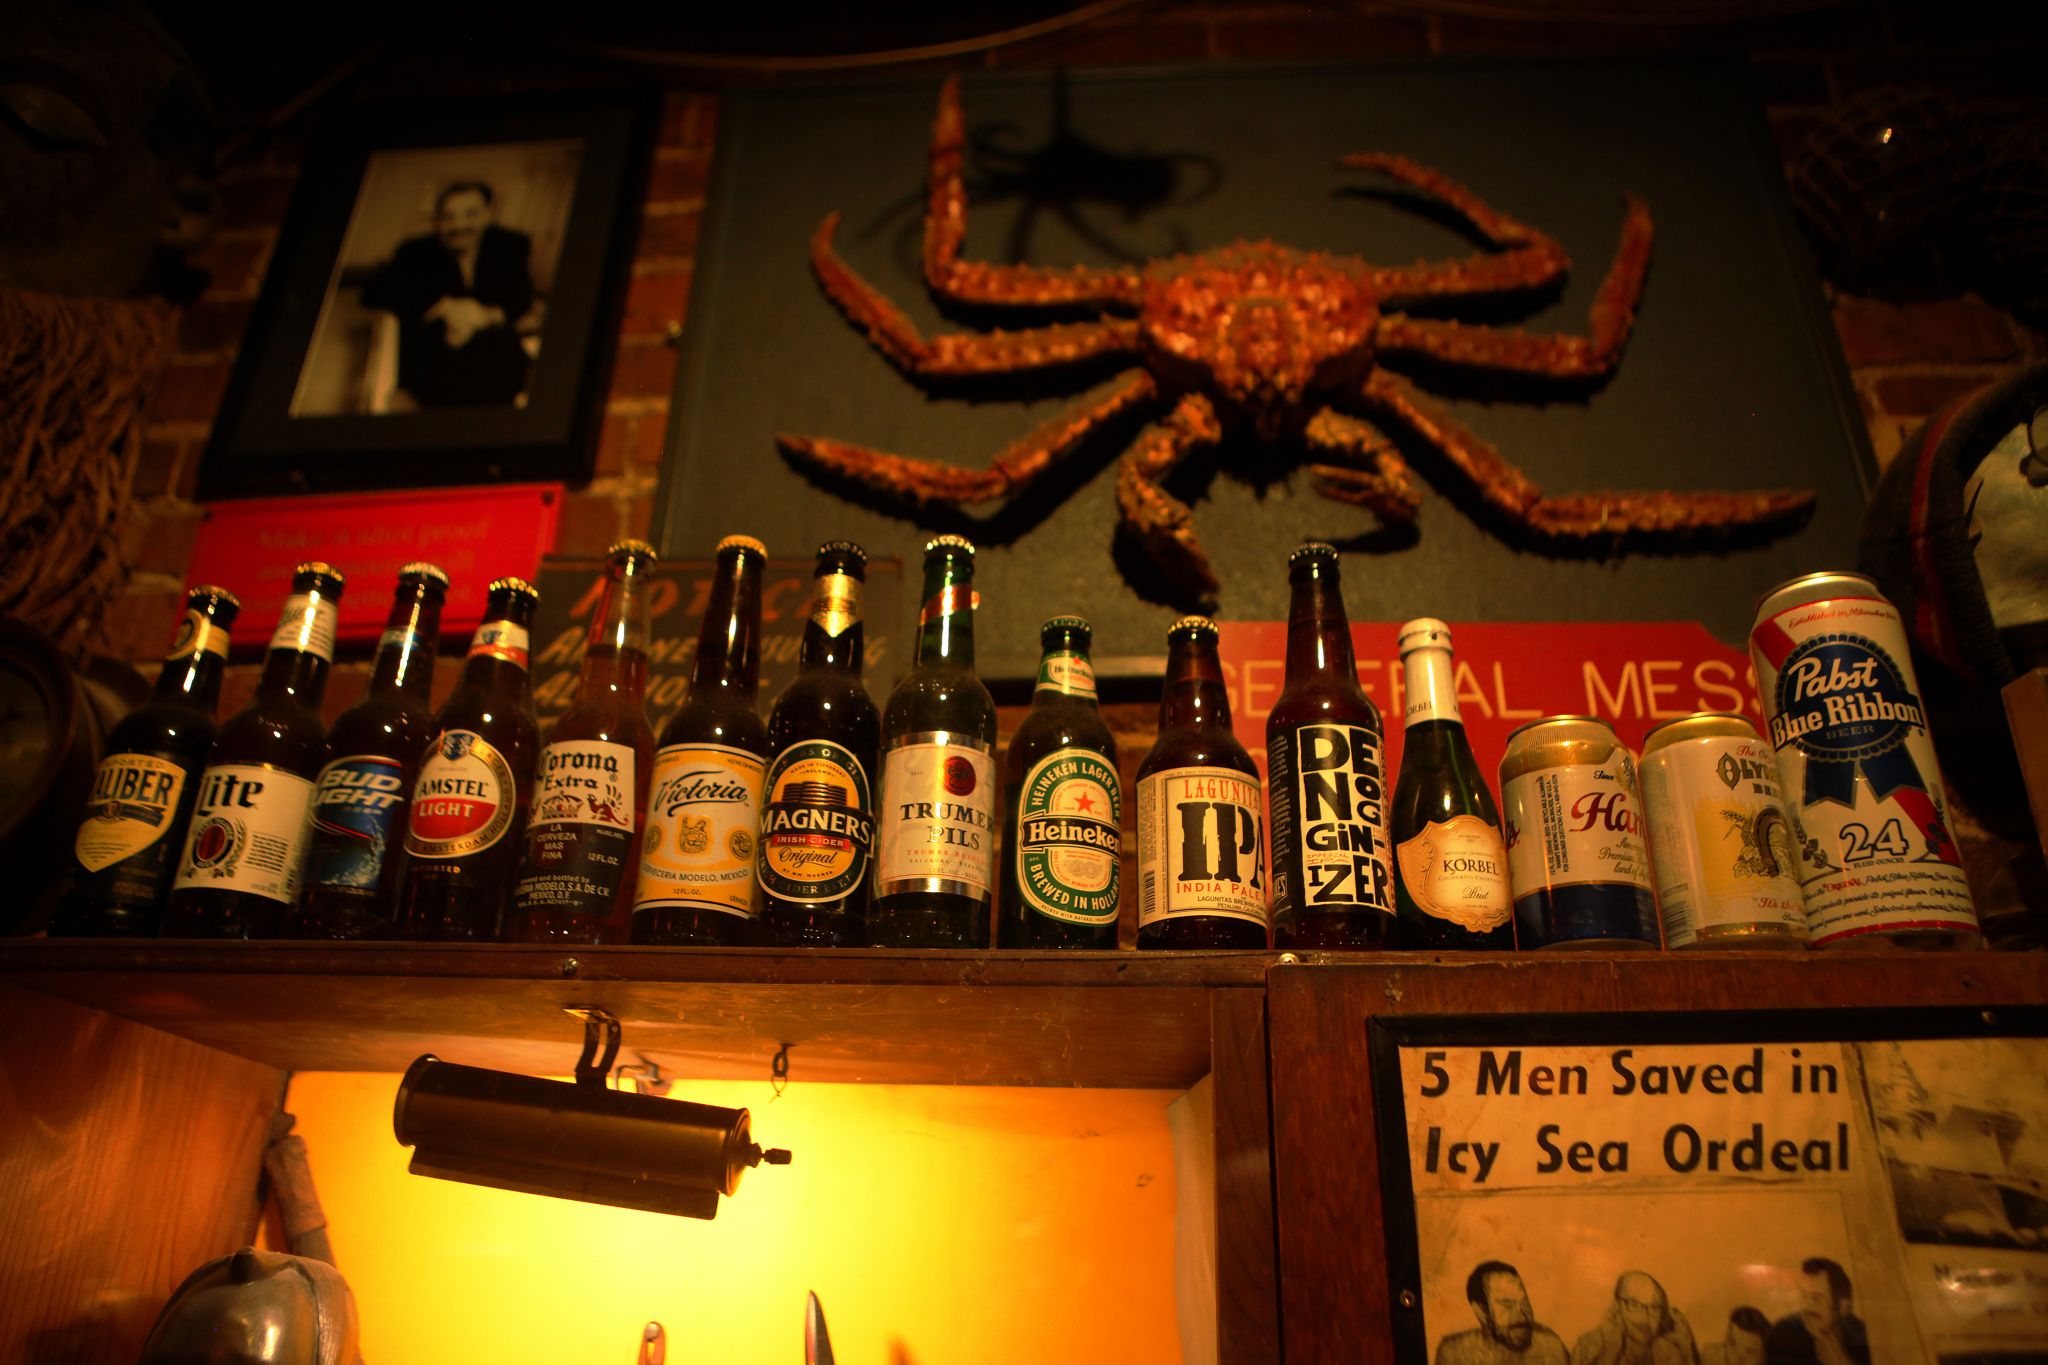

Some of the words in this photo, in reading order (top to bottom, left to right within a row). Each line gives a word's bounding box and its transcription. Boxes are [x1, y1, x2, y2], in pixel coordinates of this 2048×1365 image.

[1787, 656, 1879, 702] Pabst
[1771, 711, 1824, 749] Blue
[1823, 691, 1923, 727] Ribbon
[1826, 724, 1876, 740] BEER
[322, 769, 402, 791] BUD
[419, 778, 486, 798] AMSTEL
[544, 775, 598, 791] Extra
[1031, 761, 1078, 807] HEINEKEN
[1082, 761, 1113, 789] LAGER
[198, 775, 264, 817] Lite
[314, 788, 404, 808] IGHT
[654, 771, 750, 817] Victoria
[418, 802, 474, 818] LIGHT
[900, 802, 994, 833] TRUMER
[761, 808, 872, 845] MAGNERS
[926, 826, 980, 850] PILS
[810, 837, 844, 847] CIDER
[1839, 818, 1909, 862] 24
[778, 846, 838, 869] Original
[1443, 858, 1499, 876] KORBEL
[679, 873, 719, 882] MODELO,
[720, 869, 748, 881] MEXICO
[1030, 863, 1071, 905] BREWED
[1074, 895, 1088, 910] IN
[1176, 882, 1222, 894] INDIA
[1231, 882, 1261, 901] PALE
[1463, 886, 1489, 900] Brut
[1420, 1051, 1450, 1098] 5
[1476, 1050, 1588, 1097] Men
[1612, 1048, 1765, 1096] Saved
[1790, 1048, 1838, 1095] in
[1425, 1126, 1500, 1183] Icy
[1537, 1124, 1630, 1175] Sea
[1663, 1123, 1850, 1174] Ordeal
